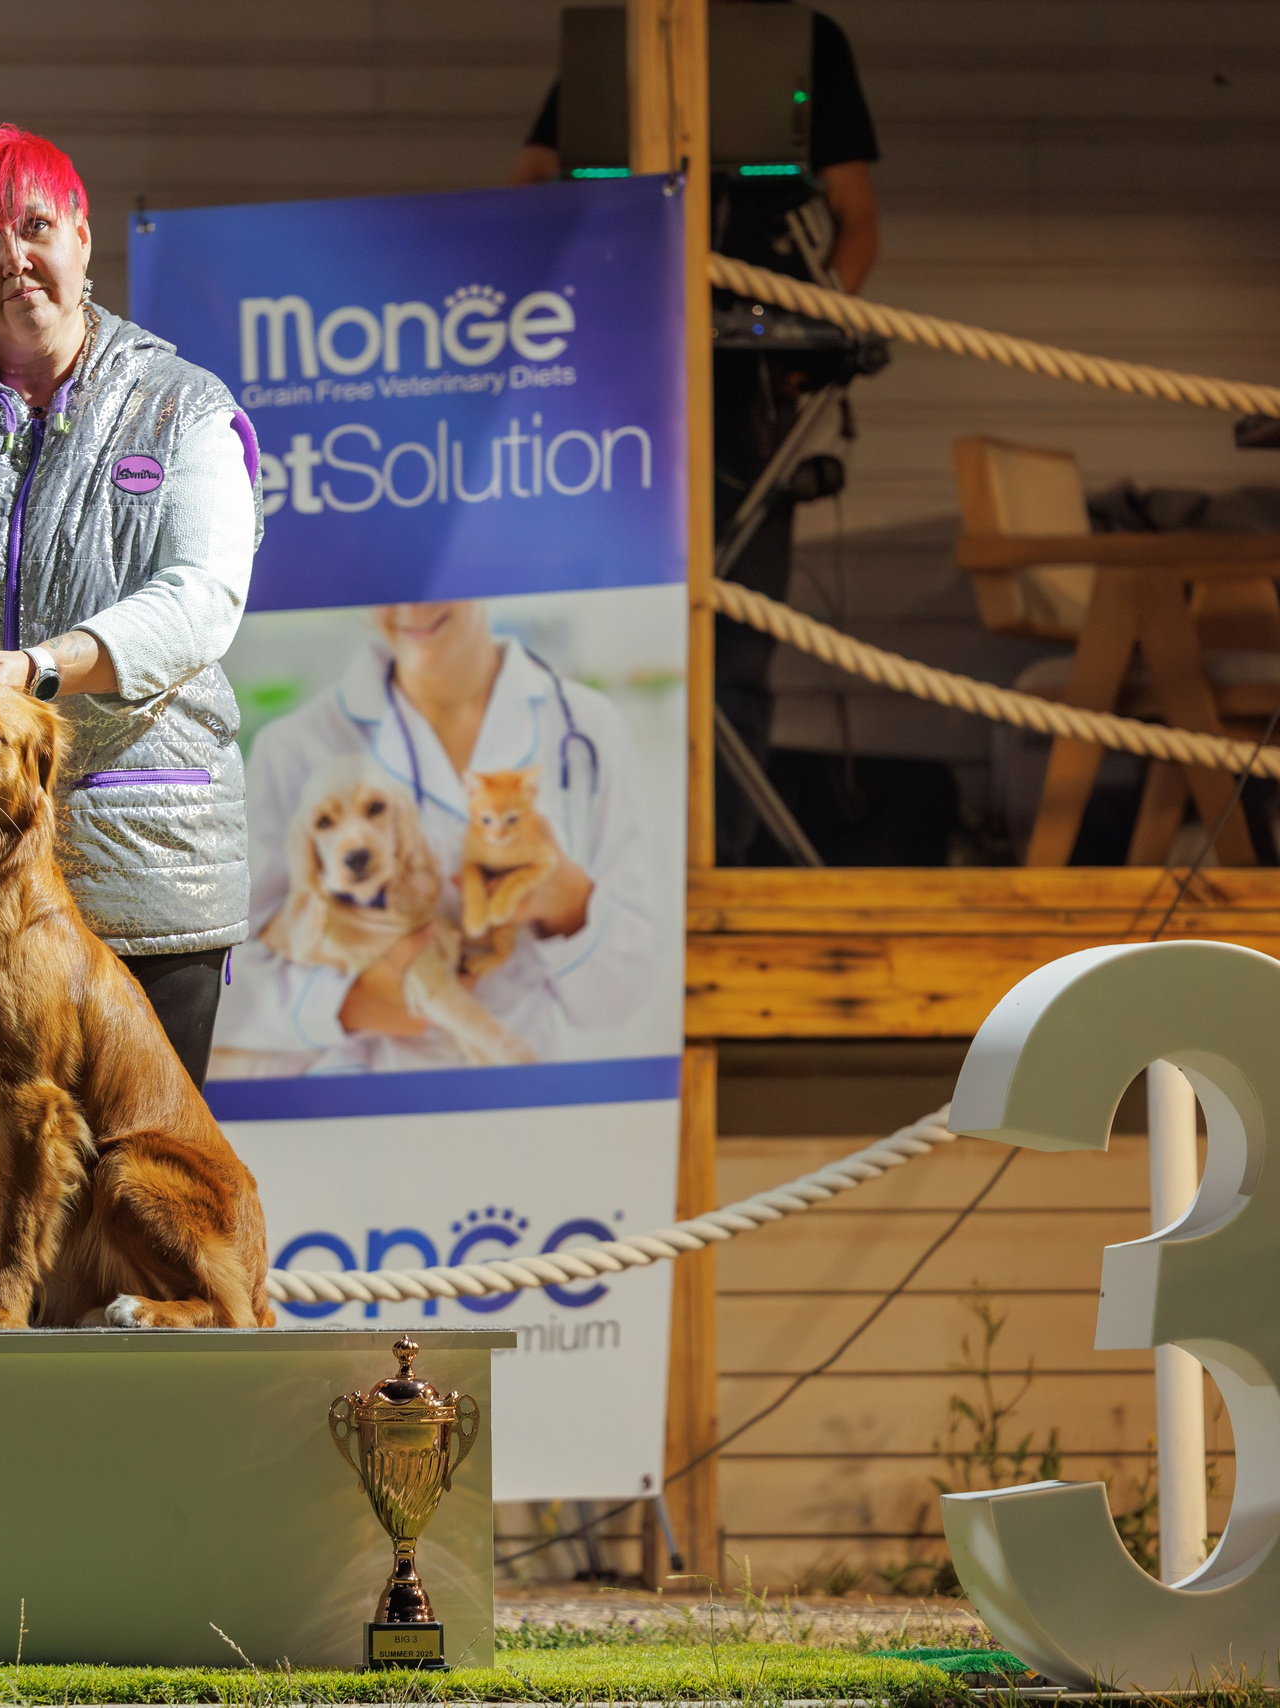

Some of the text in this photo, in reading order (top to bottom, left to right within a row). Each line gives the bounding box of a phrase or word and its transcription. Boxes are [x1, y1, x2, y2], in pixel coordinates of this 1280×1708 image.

[240, 364, 578, 409] Grain Free Veterinary Diets
[261, 411, 652, 518] etSolution
[942, 941, 1280, 1692] 3
[379, 1650, 434, 1658] SUMMER 2025
[394, 1635, 418, 1643] BIG 3
